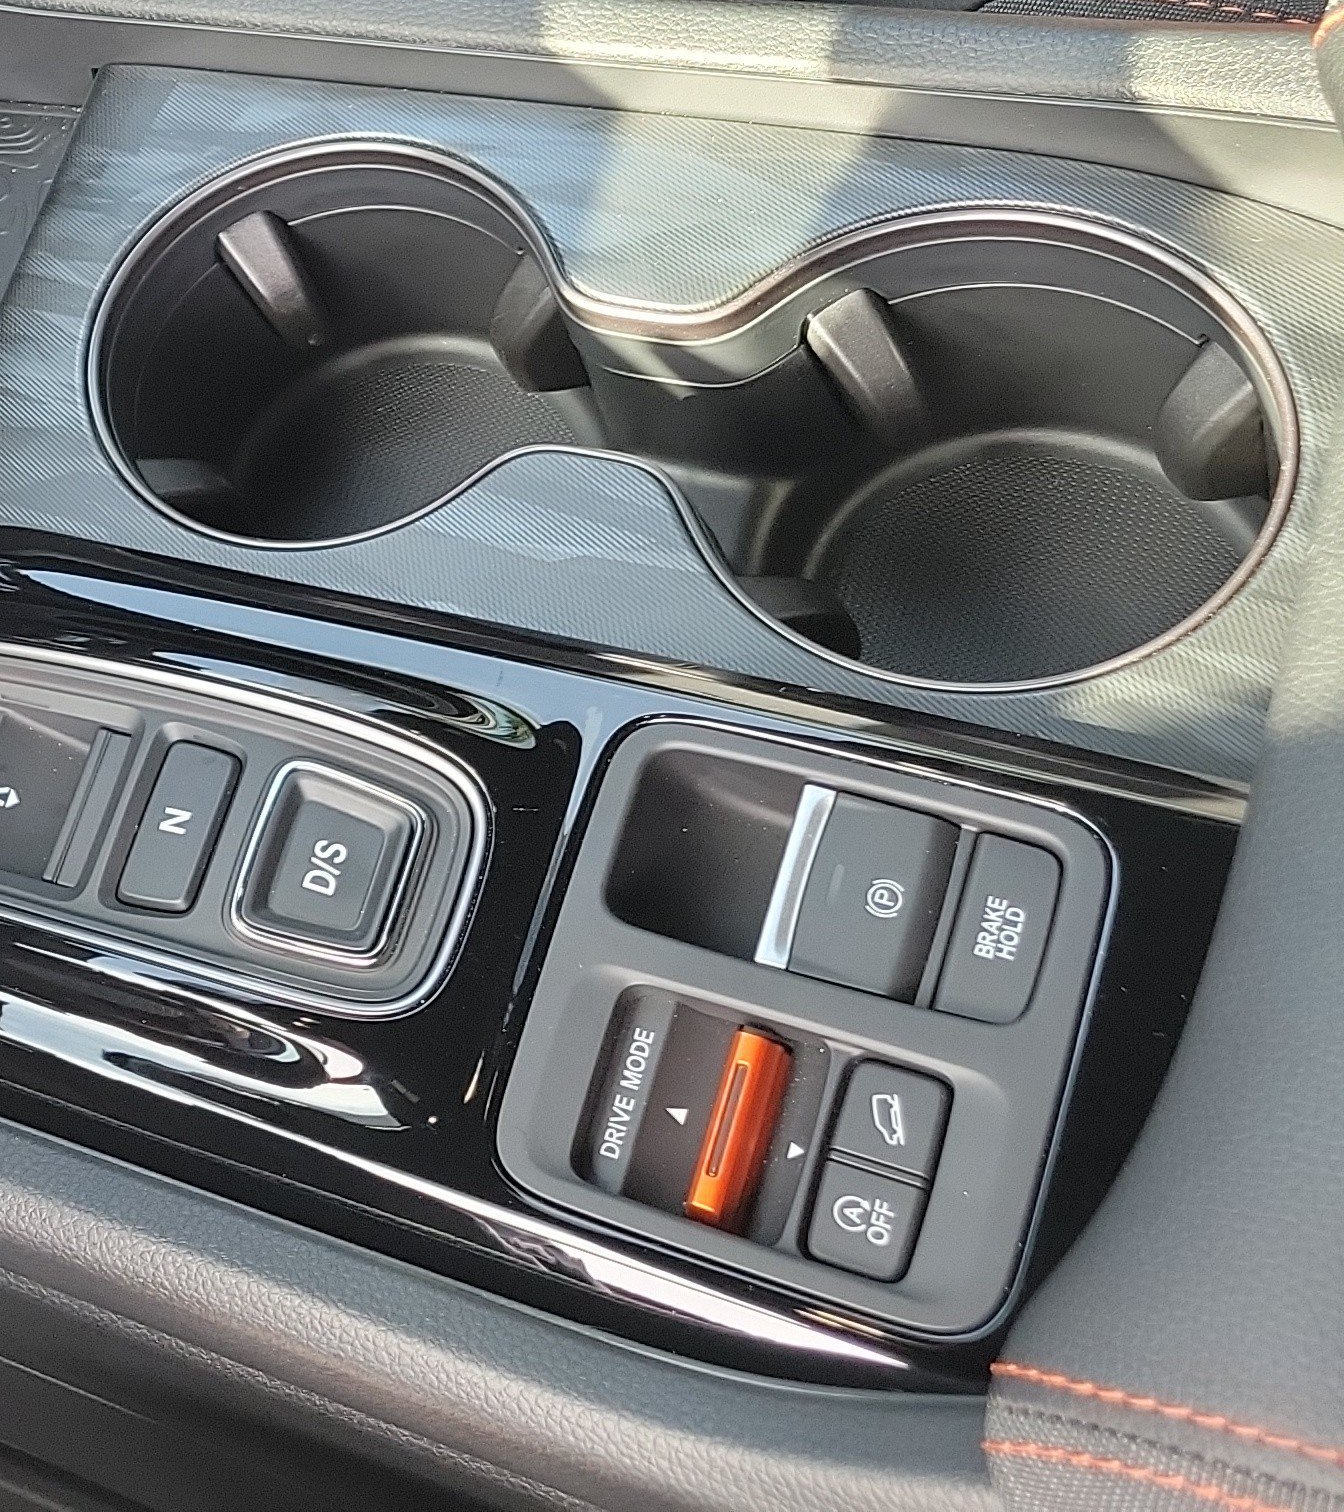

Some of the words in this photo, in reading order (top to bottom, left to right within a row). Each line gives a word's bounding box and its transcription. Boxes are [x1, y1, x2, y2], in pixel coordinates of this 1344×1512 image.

[159, 806, 193, 837] N
[301, 839, 348, 900] D/S
[973, 895, 1009, 961] BRAKE
[995, 906, 1027, 962] HOLD
[599, 1090, 636, 1160] DRIVE
[620, 1027, 655, 1094] MODE
[866, 1198, 895, 1247] OFF
